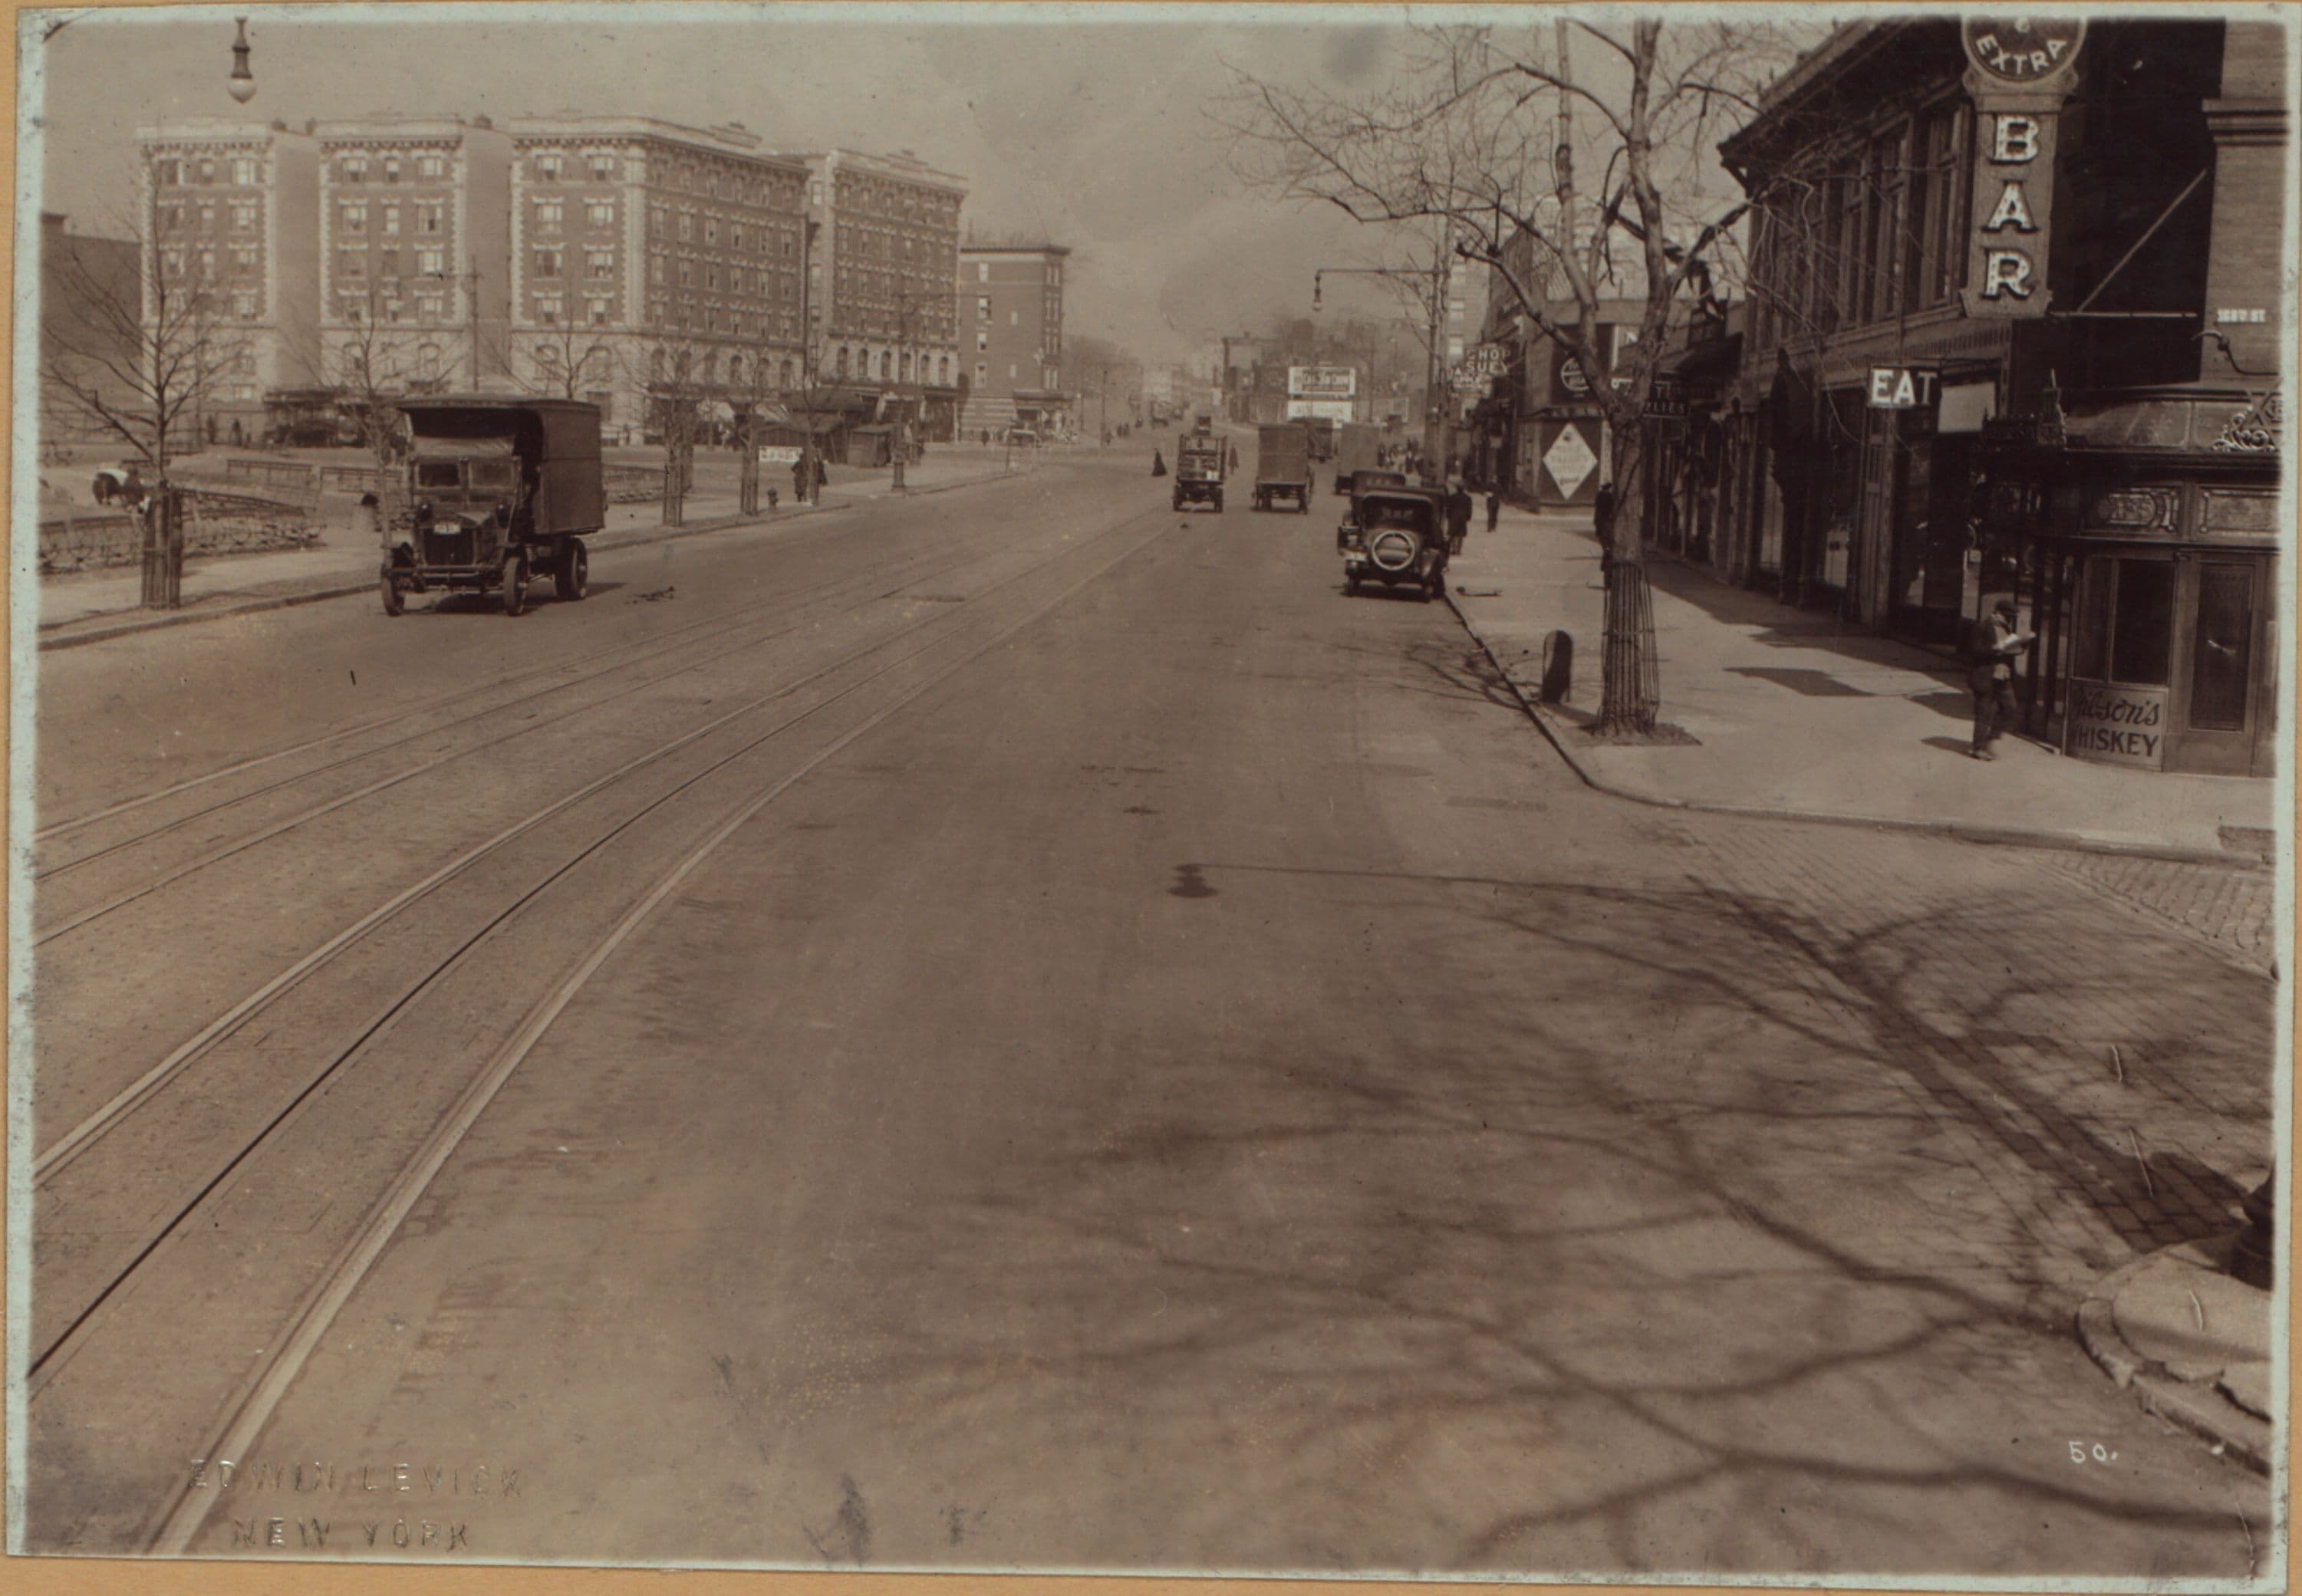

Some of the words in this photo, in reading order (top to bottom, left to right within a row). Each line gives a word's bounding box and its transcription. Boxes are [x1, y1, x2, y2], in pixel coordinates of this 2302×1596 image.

[1975, 33, 2067, 74] EXTRA
[1981, 114, 2040, 300] BAR
[1870, 368, 1938, 405] EAT
